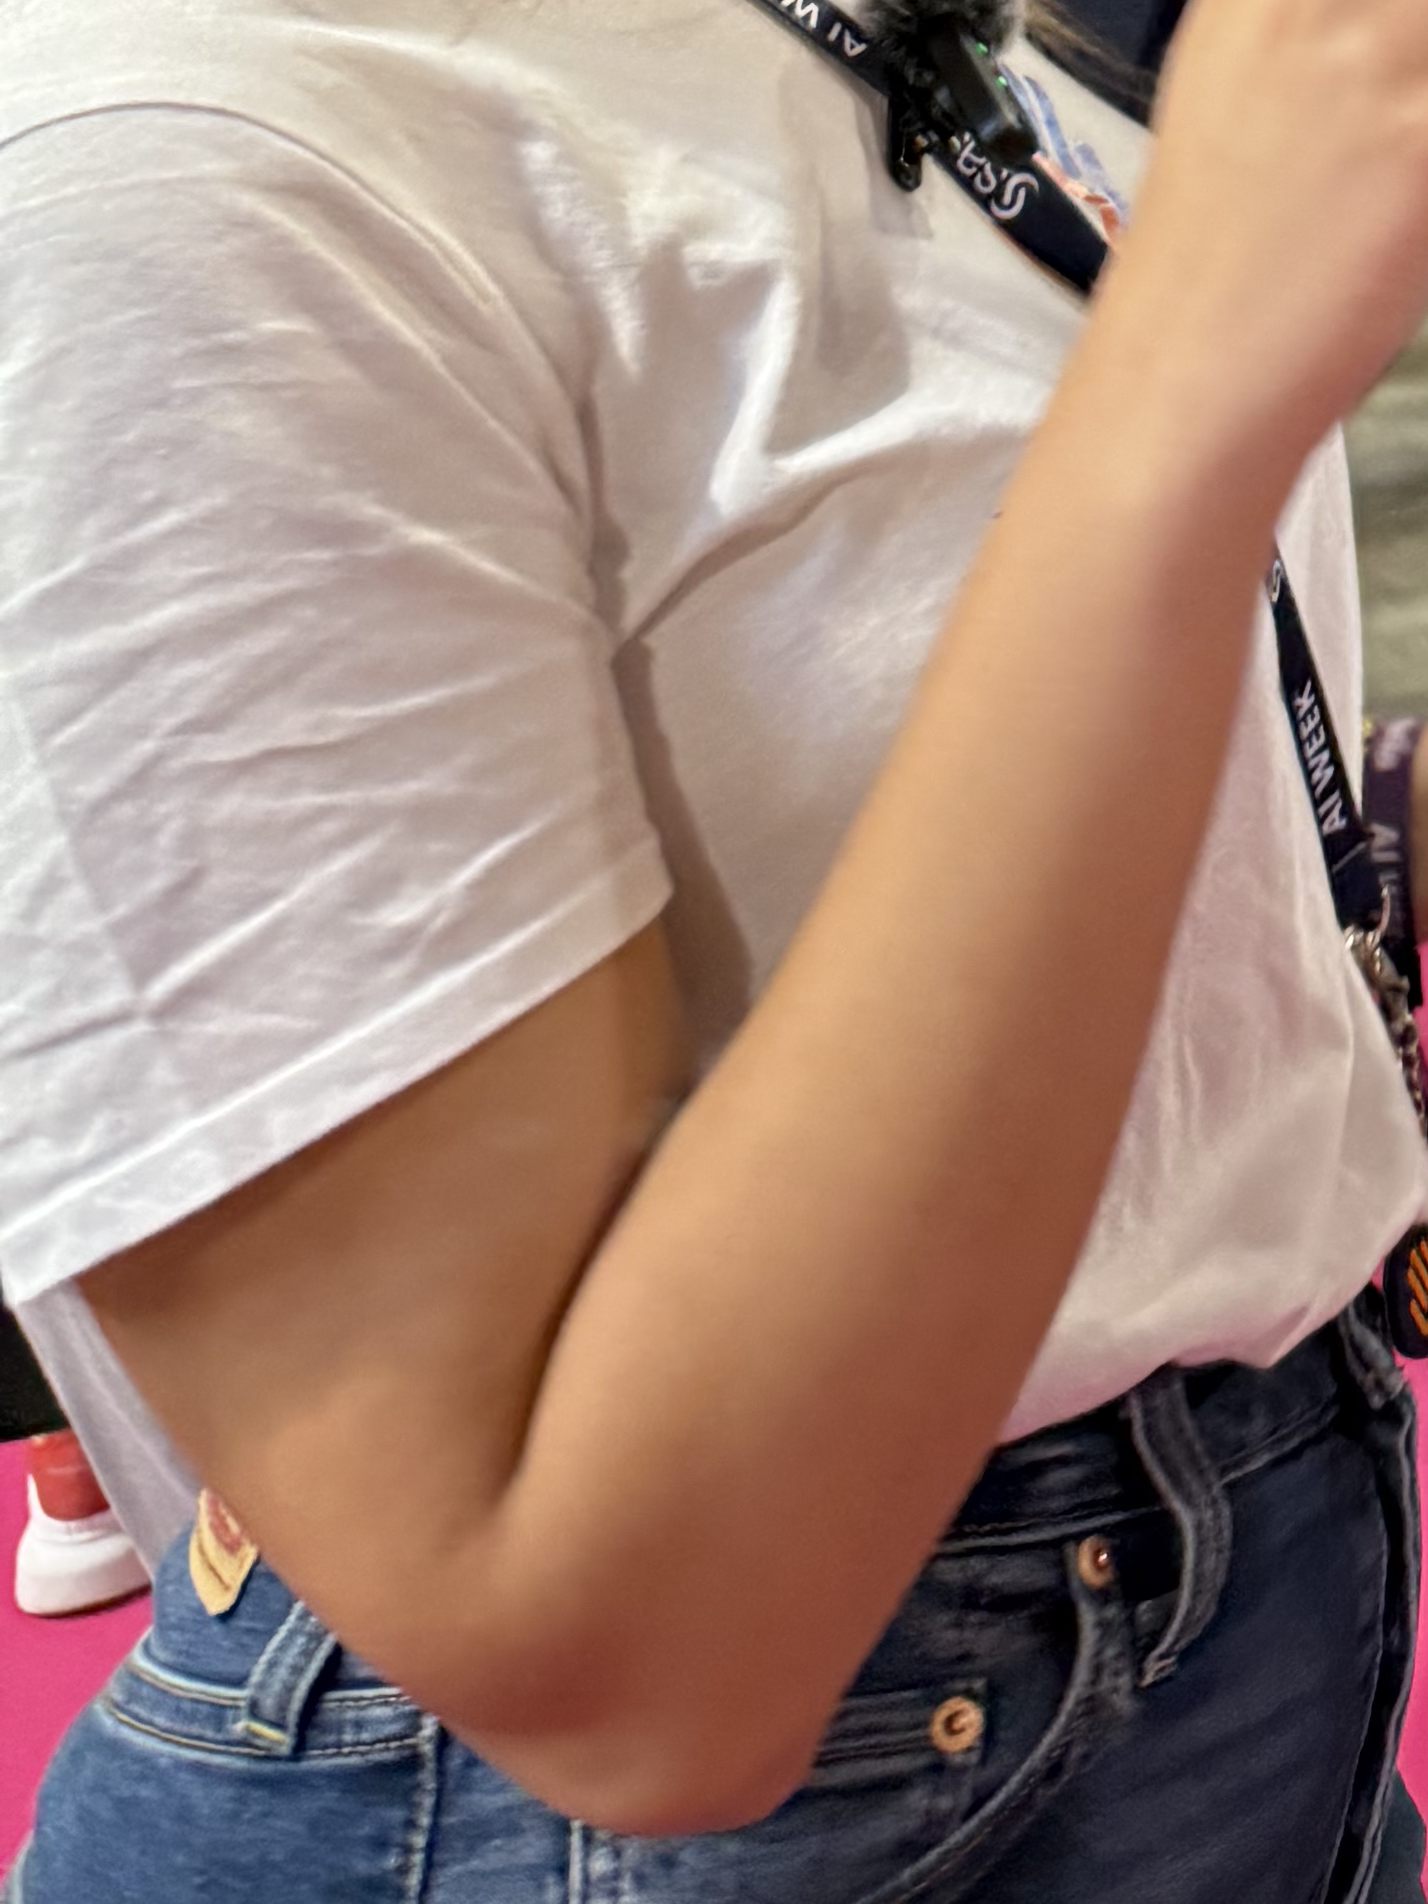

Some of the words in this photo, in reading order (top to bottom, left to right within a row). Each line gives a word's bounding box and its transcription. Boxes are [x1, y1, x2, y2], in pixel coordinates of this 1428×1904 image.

[827, 22, 868, 57] AI
[1294, 679, 1337, 798] WEEK
[1318, 796, 1348, 837] AI
